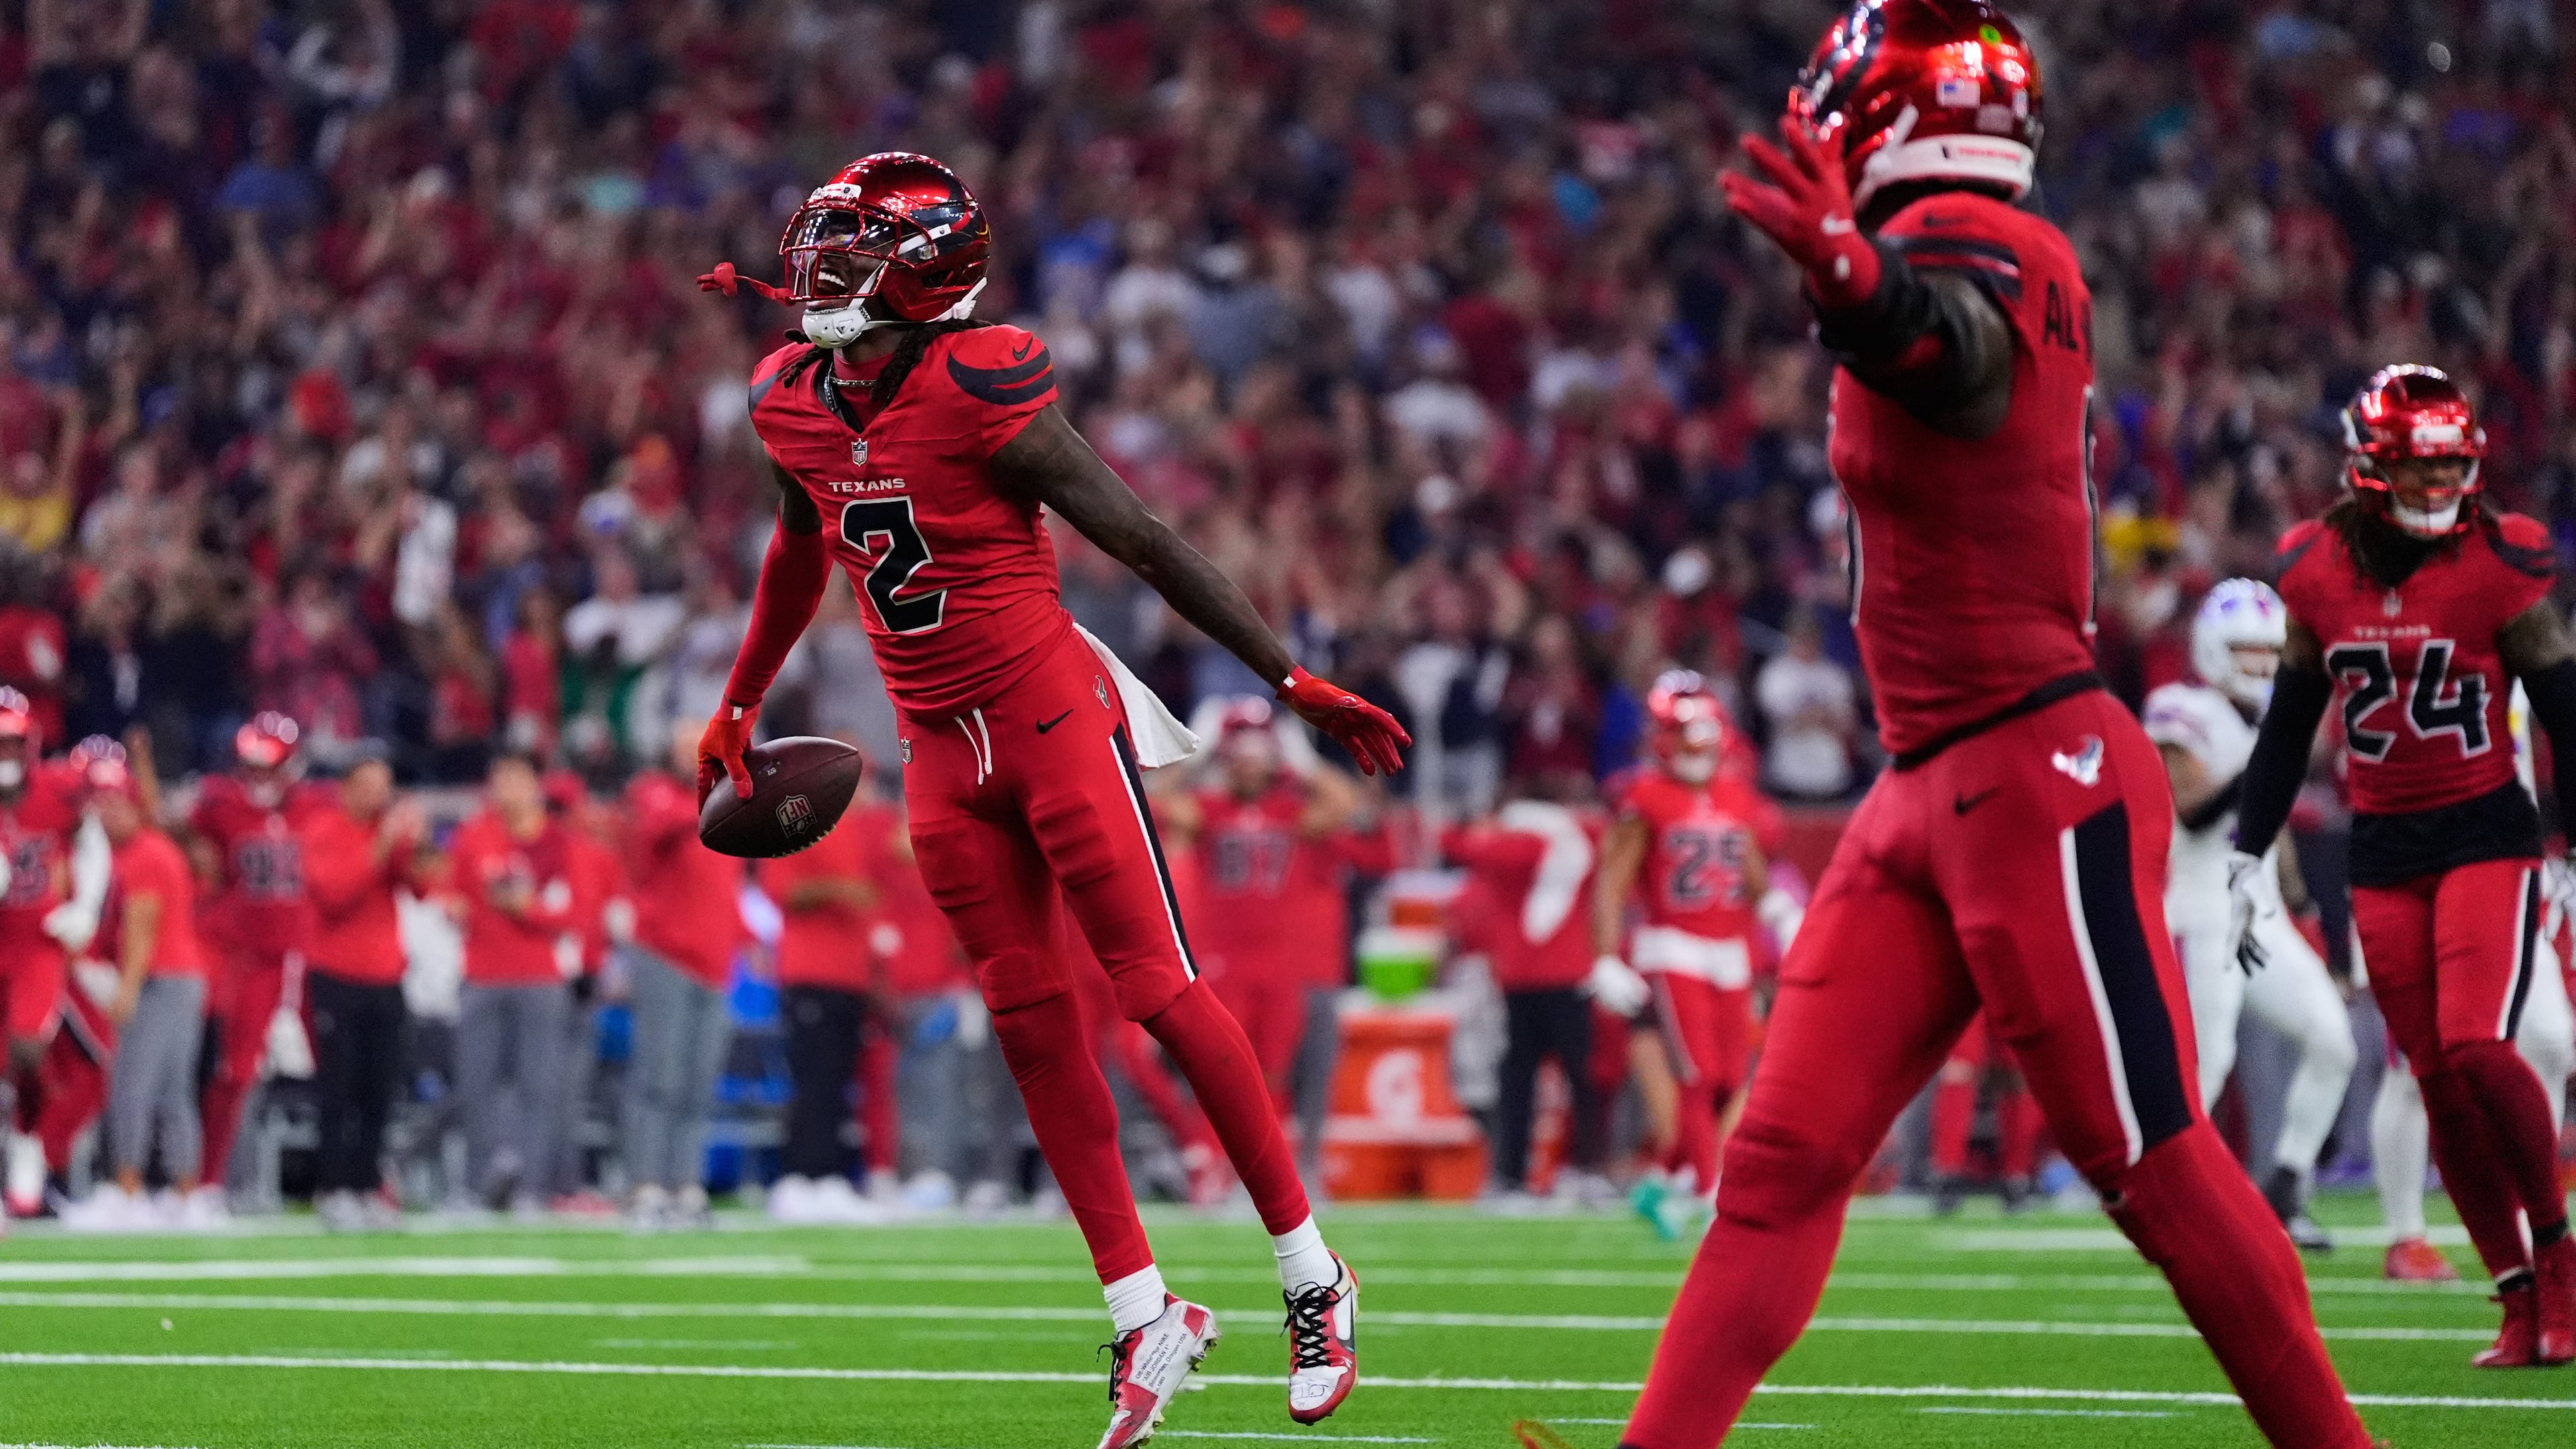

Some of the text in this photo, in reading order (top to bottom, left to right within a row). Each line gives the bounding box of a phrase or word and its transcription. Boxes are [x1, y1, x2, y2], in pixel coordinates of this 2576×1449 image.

[828, 478, 906, 493] TEXANS
[841, 495, 948, 634] 2
[2324, 639, 2493, 763] 24
[1158, 1332, 1169, 1346] NIKE
[1165, 1344, 1180, 1362] Oregon
[1178, 1333, 1187, 1344] USA
[1150, 1350, 1166, 1372] JORDAN
